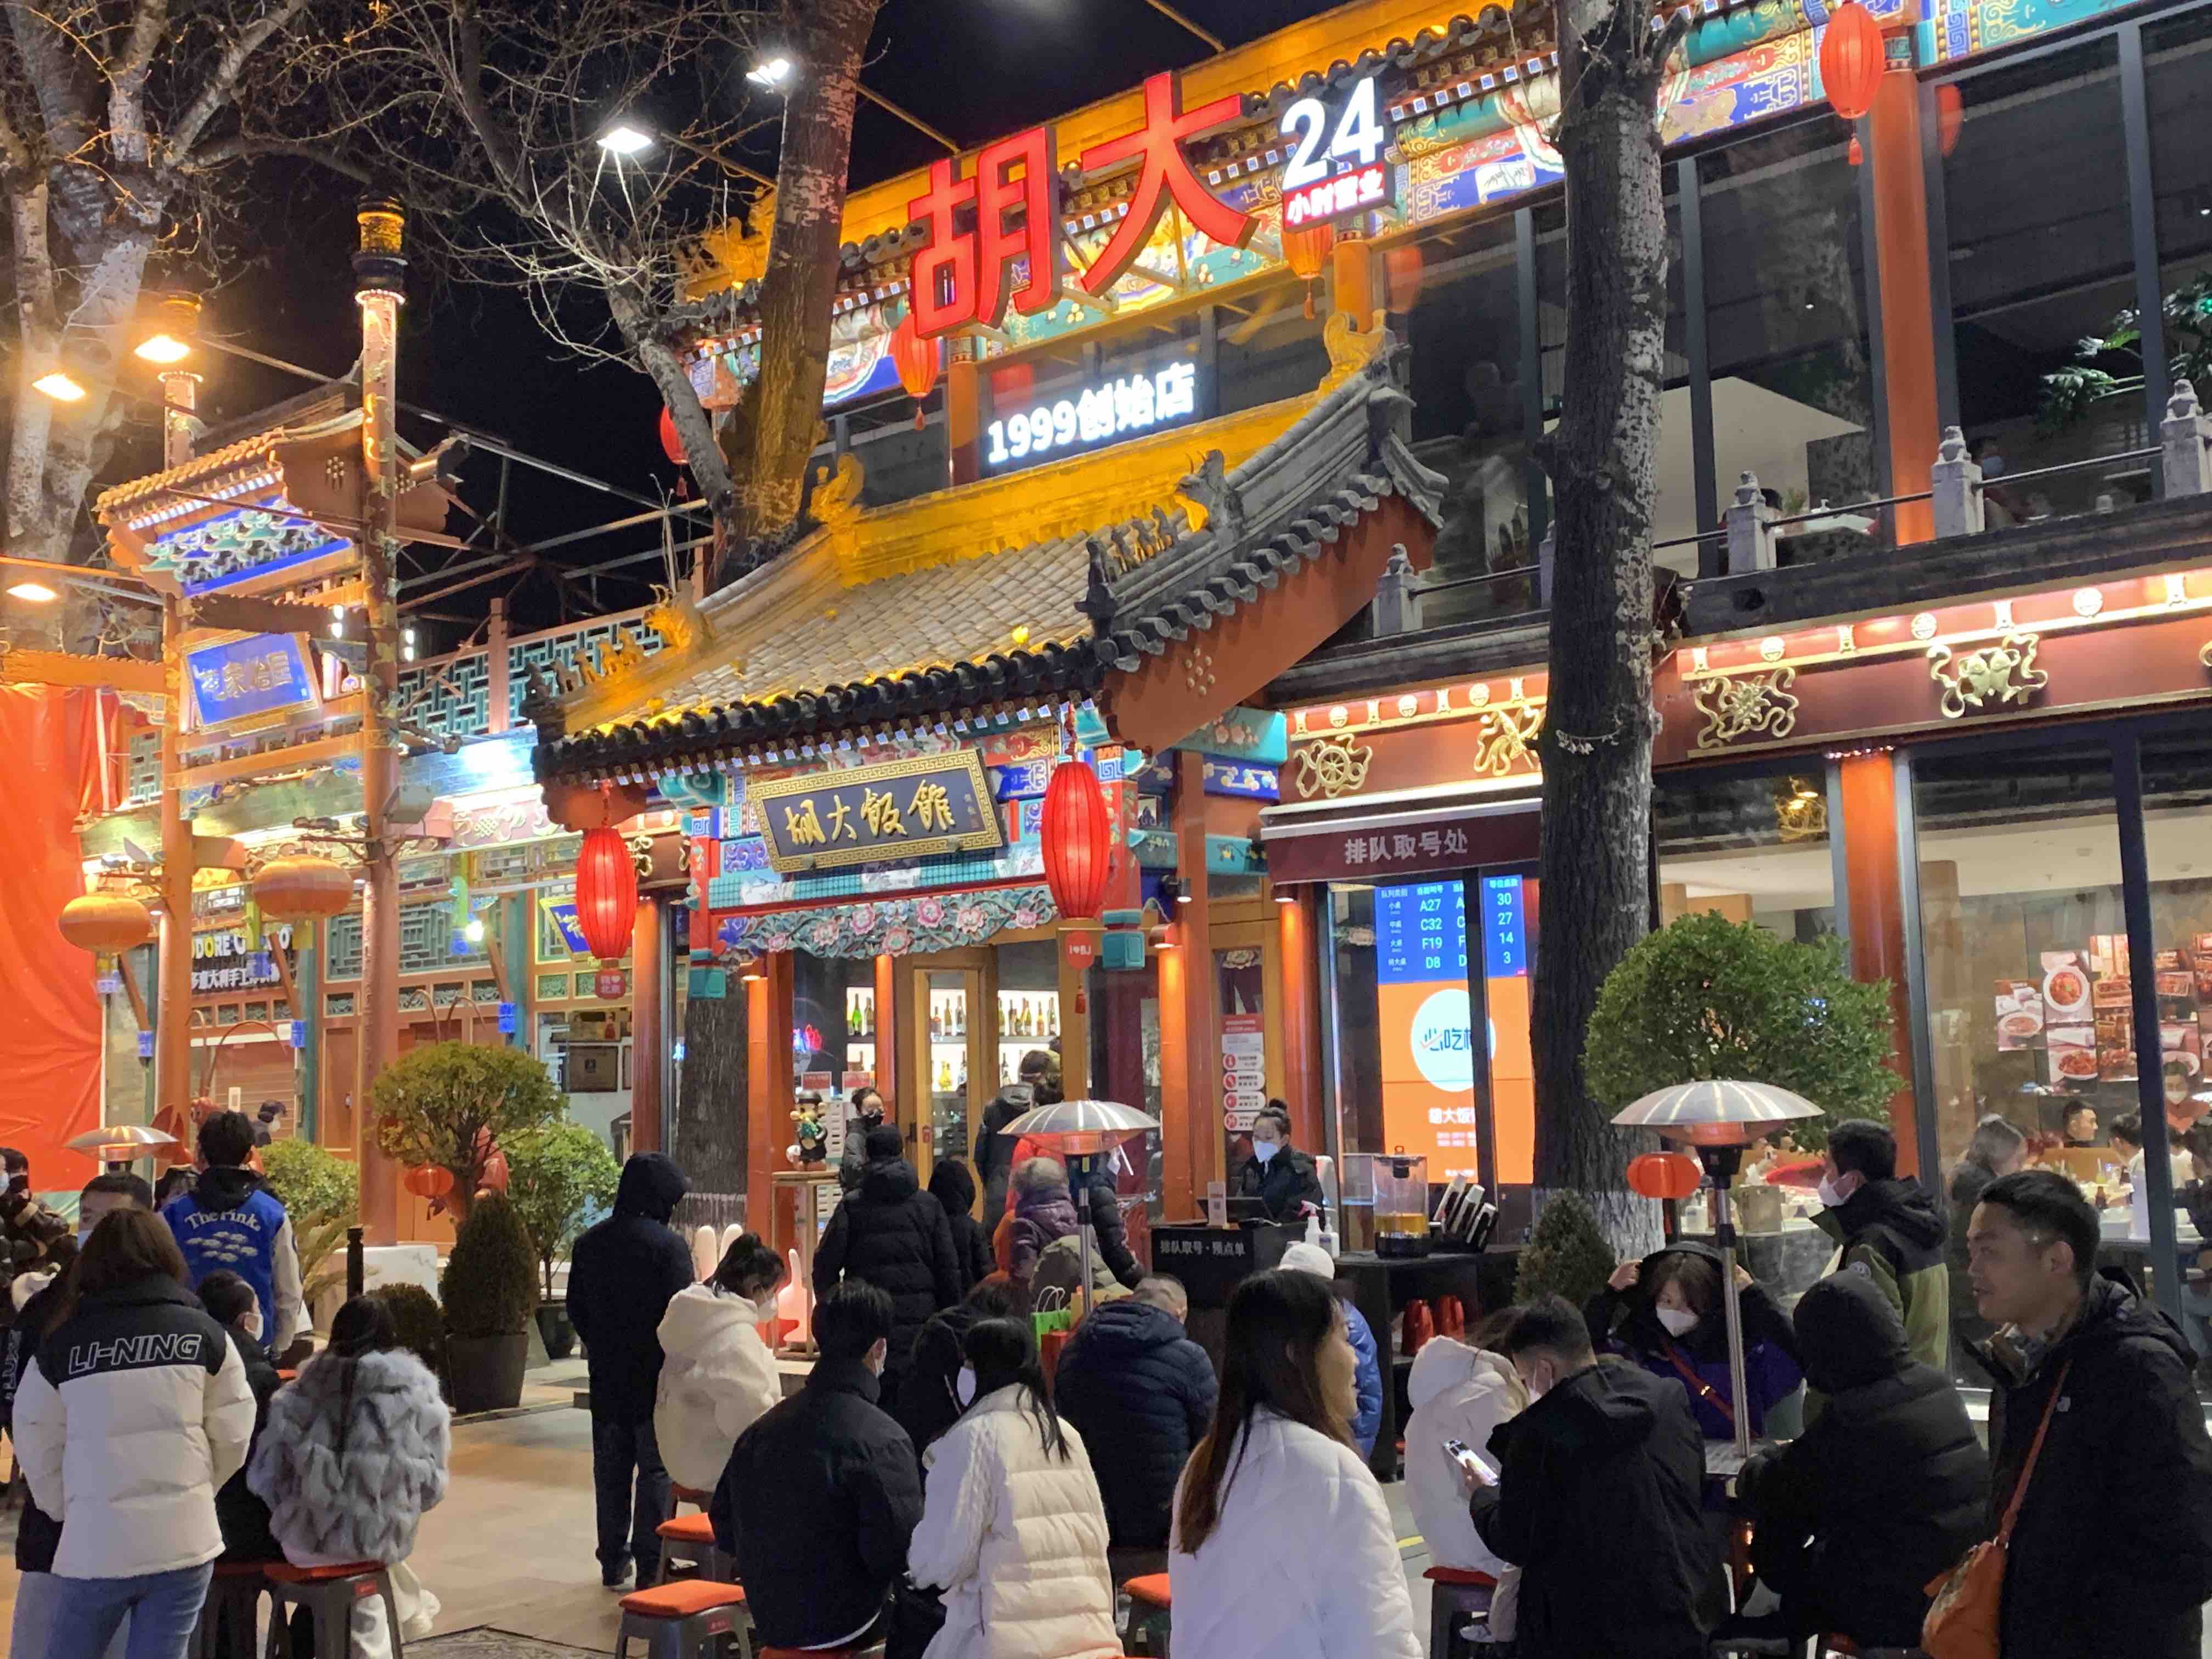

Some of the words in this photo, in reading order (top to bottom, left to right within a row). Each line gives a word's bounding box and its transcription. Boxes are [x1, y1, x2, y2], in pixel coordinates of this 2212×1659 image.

[1281, 76, 1384, 190] 24
[908, 71, 1257, 340] 胡大
[1287, 168, 1384, 224] 小时营业
[988, 362, 1195, 463] 1999创始店
[1345, 828, 1468, 865] 排队取号处
[1420, 898, 1441, 912] A27
[1497, 892, 1512, 906] 30
[1420, 917, 1443, 931] C32
[1498, 912, 1513, 926] 27
[1421, 936, 1443, 950] F19
[1499, 932, 1514, 944] 14
[1425, 956, 1441, 969] D8
[1503, 951, 1511, 964] 3
[1429, 1107, 1476, 1125] 胡大饭
[184, 1211, 218, 1229] The
[69, 1334, 202, 1374] LI-NING
